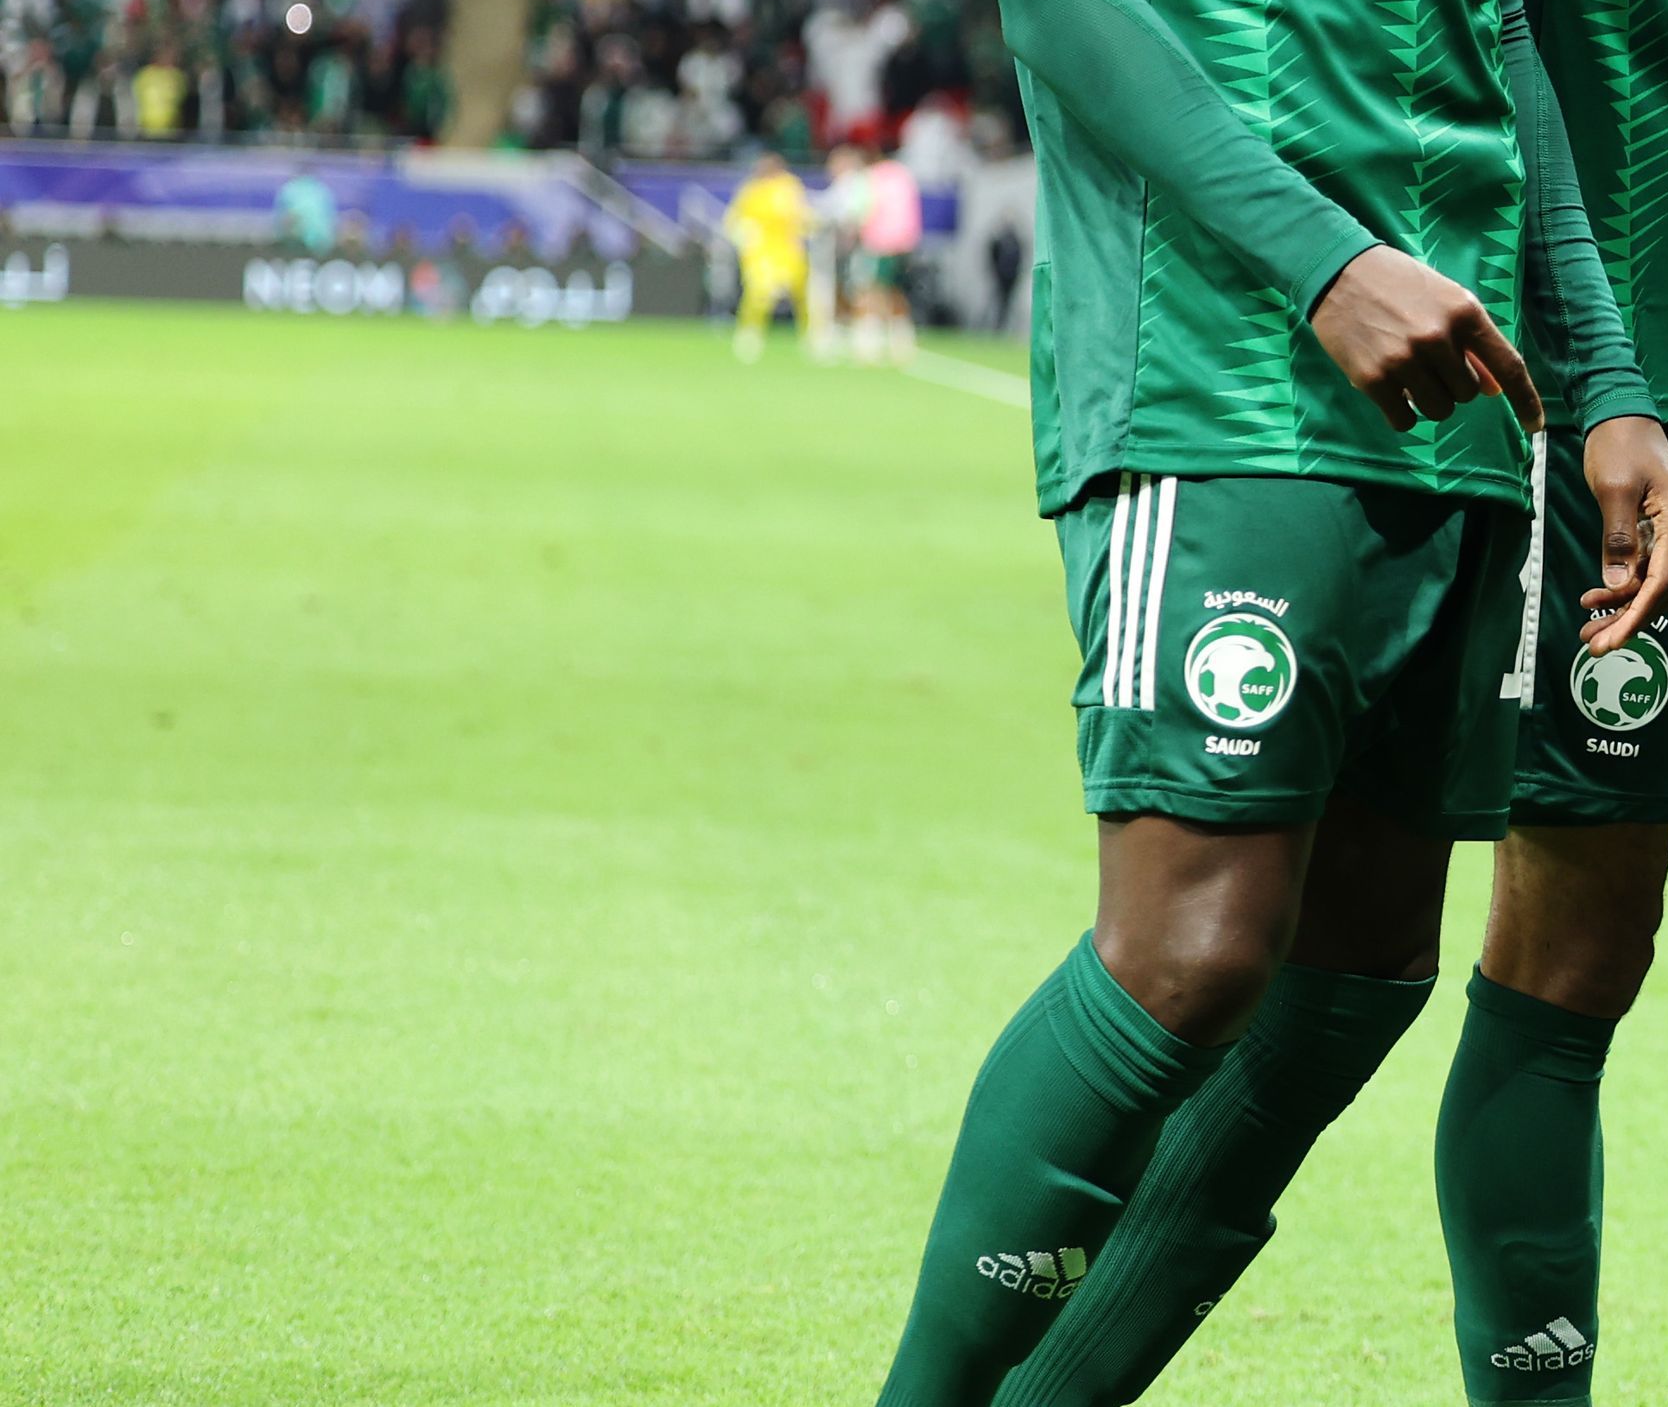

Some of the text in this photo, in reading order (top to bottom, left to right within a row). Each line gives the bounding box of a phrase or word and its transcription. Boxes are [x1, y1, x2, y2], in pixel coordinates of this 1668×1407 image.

[243, 257, 405, 314] NEOM
[1204, 590, 1289, 618] السعودية
[1241, 683, 1274, 696] SAFF
[1622, 692, 1651, 704] SAFF
[1205, 735, 1261, 755] SAUDI
[1586, 738, 1640, 758] SAUDI
[976, 1255, 1083, 1300] adida
[1491, 1344, 1595, 1371] adidas
